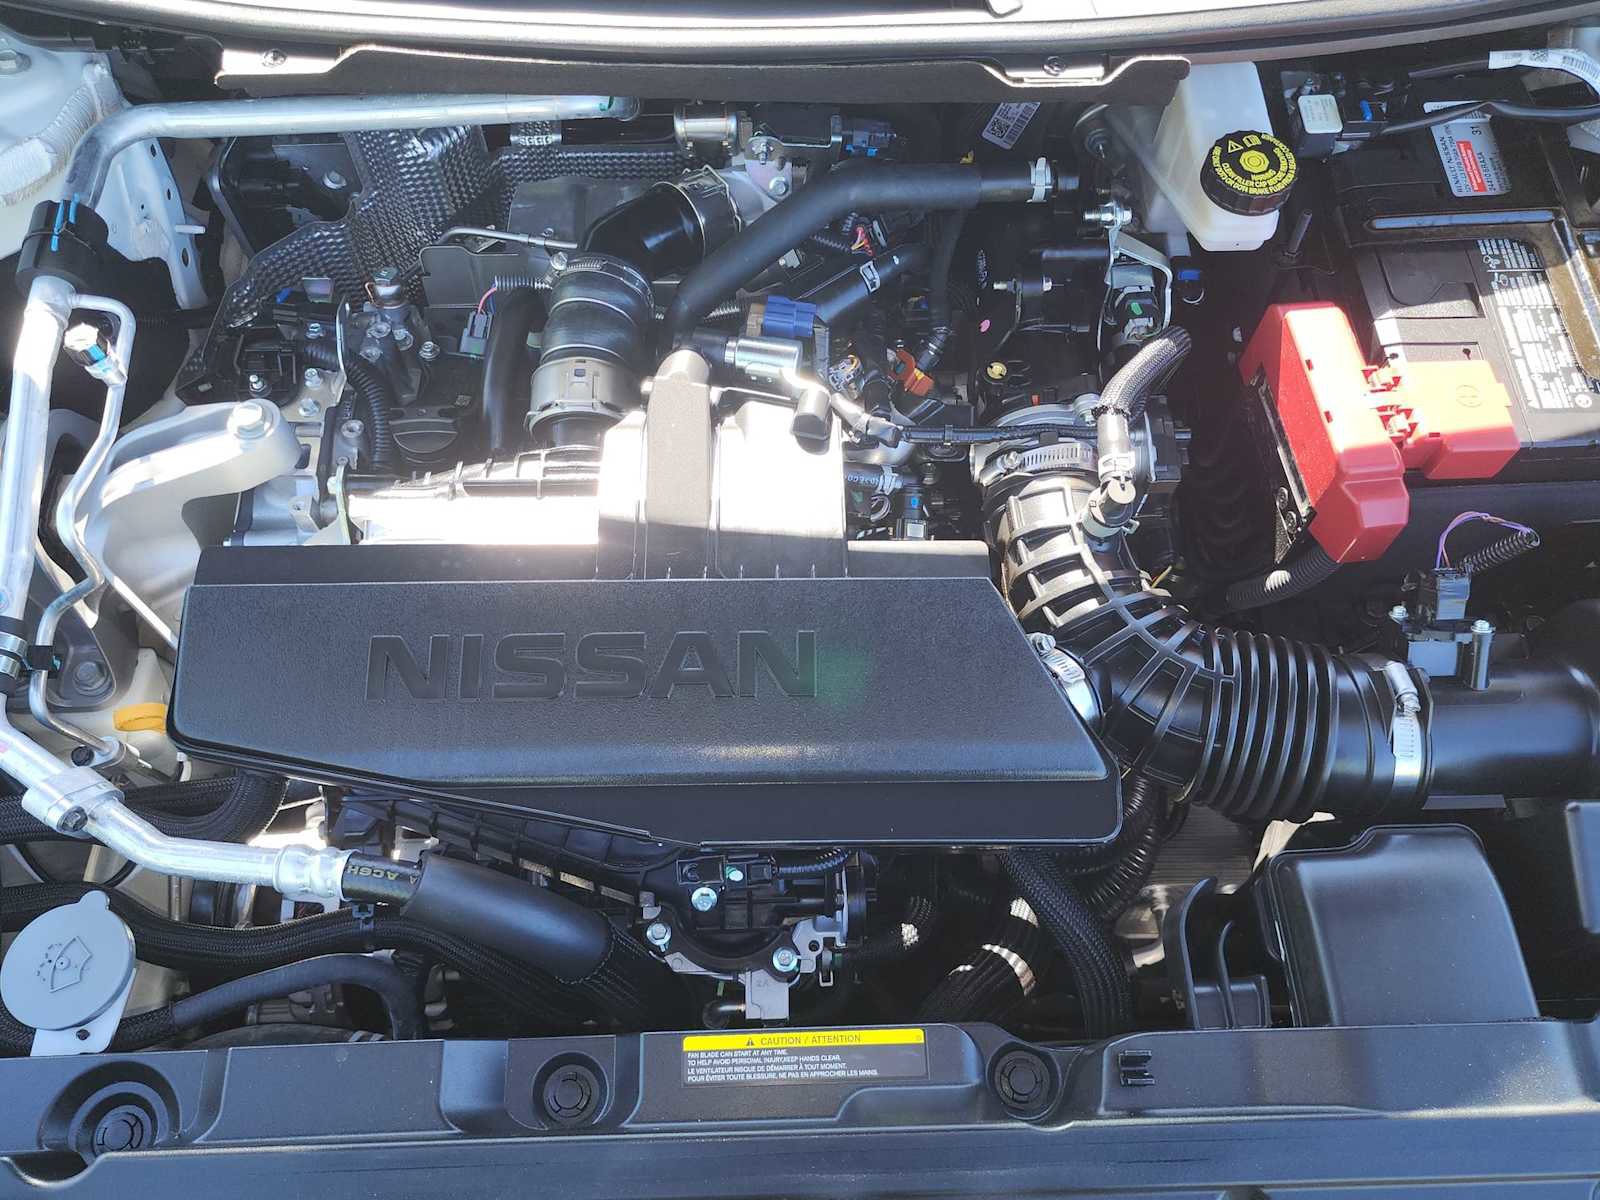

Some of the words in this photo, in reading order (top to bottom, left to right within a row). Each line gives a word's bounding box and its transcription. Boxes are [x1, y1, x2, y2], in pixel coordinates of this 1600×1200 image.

[1469, 126, 1482, 136] 31
[1222, 162, 1237, 180] CLEAN
[1232, 175, 1254, 187] FILLER
[1254, 179, 1269, 188] CAP
[1266, 170, 1287, 187] BEFORE
[1248, 186, 1271, 195] BRAKE
[365, 630, 817, 700] NISSAN
[760, 1036, 801, 1046] CAUTION
[811, 1034, 861, 1044] ATTENTION
[688, 1051, 699, 1059] FAN
[731, 1057, 762, 1065] PERSONAL
[799, 1055, 820, 1063] HANDS
[696, 1066, 733, 1075] VENTILATEUR
[734, 1065, 756, 1073] RISQUE
[766, 1063, 798, 1072] DÉMARRER
[805, 1063, 820, 1071] TOUT
[727, 1073, 745, 1081] TOUTE
[810, 1070, 846, 1078] APPROCHER
